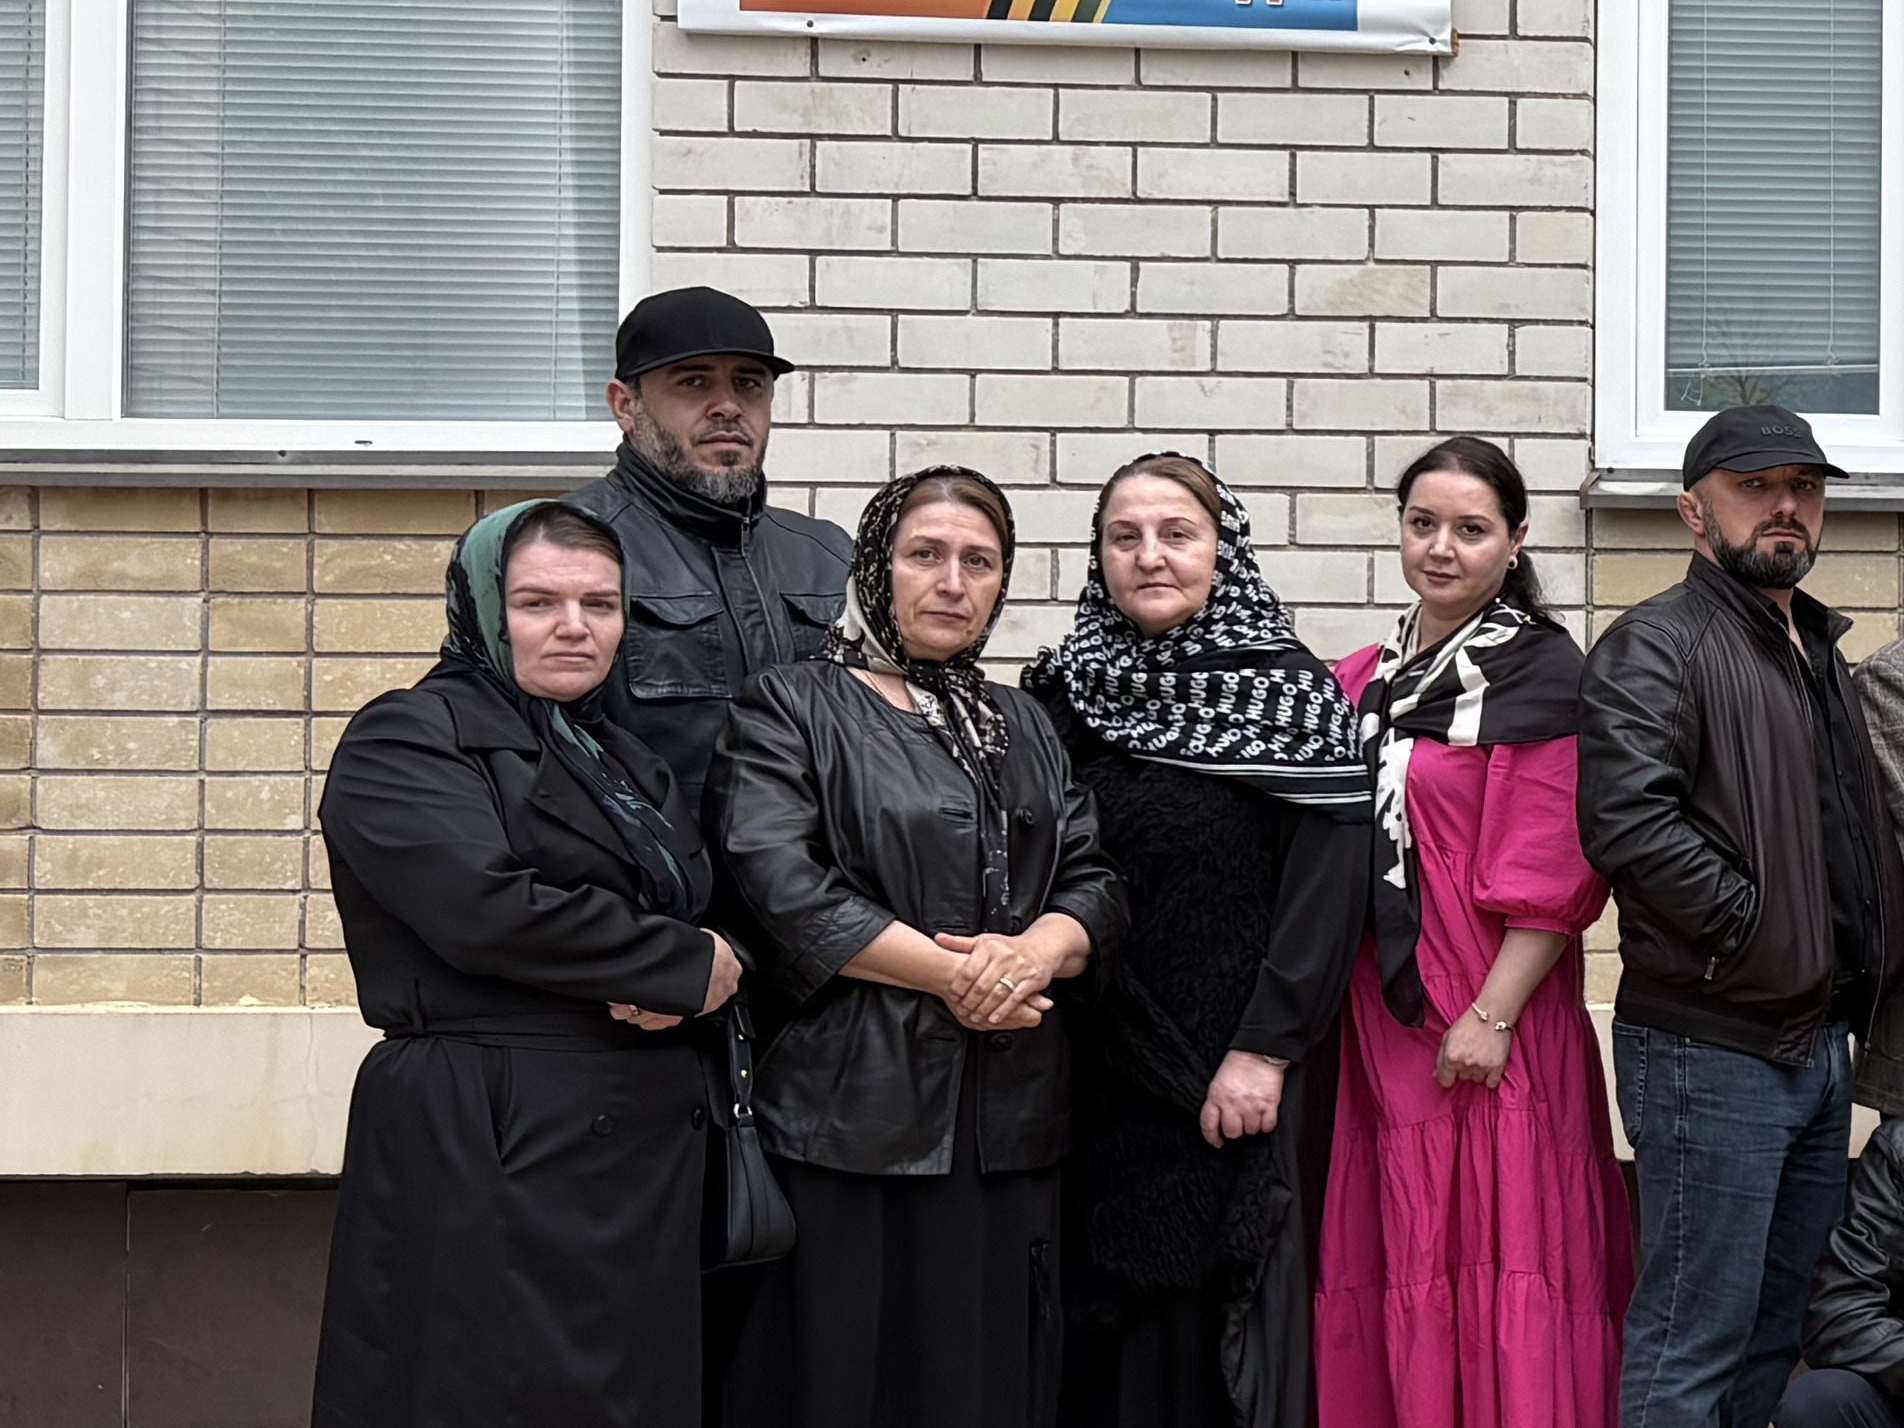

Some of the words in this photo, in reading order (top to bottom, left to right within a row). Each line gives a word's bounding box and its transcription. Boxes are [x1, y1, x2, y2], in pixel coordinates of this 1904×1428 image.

[1216, 672, 1240, 714] HUGO
[1245, 676, 1270, 721] HUGO
[1274, 683, 1298, 727] HUGO
[1303, 691, 1324, 734] HUGO
[1325, 702, 1346, 746] HUGO
